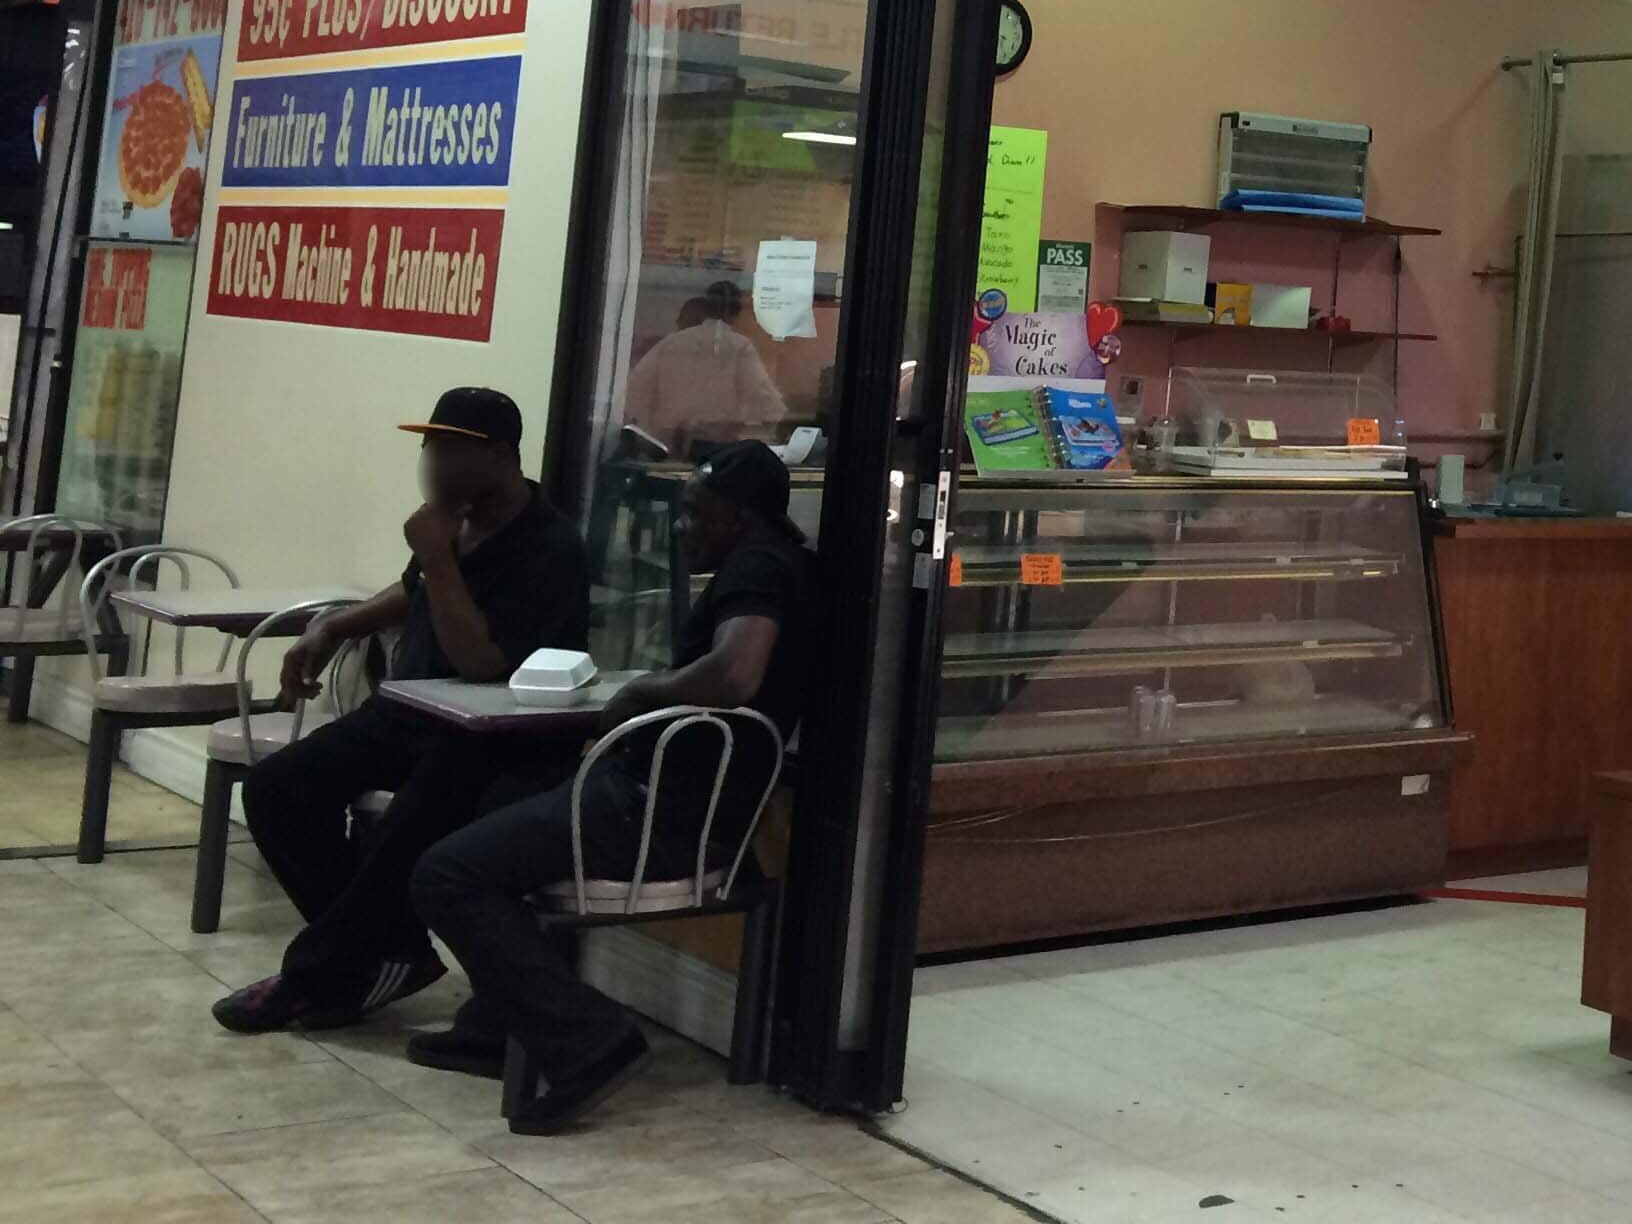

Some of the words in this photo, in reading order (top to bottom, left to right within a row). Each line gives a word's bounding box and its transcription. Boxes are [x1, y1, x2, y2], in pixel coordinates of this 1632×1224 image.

[233, 96, 327, 169] Furniture
[334, 87, 354, 167] &
[361, 86, 502, 166] Mattresses
[1047, 248, 1084, 265] PASS
[217, 221, 280, 299] RUGS
[281, 223, 352, 305] Machine
[360, 224, 378, 308] &
[382, 225, 486, 317] Handmade
[1024, 317, 1041, 328] The
[1005, 324, 1056, 351] Magic
[1044, 345, 1056, 356] of
[1015, 356, 1069, 376] Cakes
